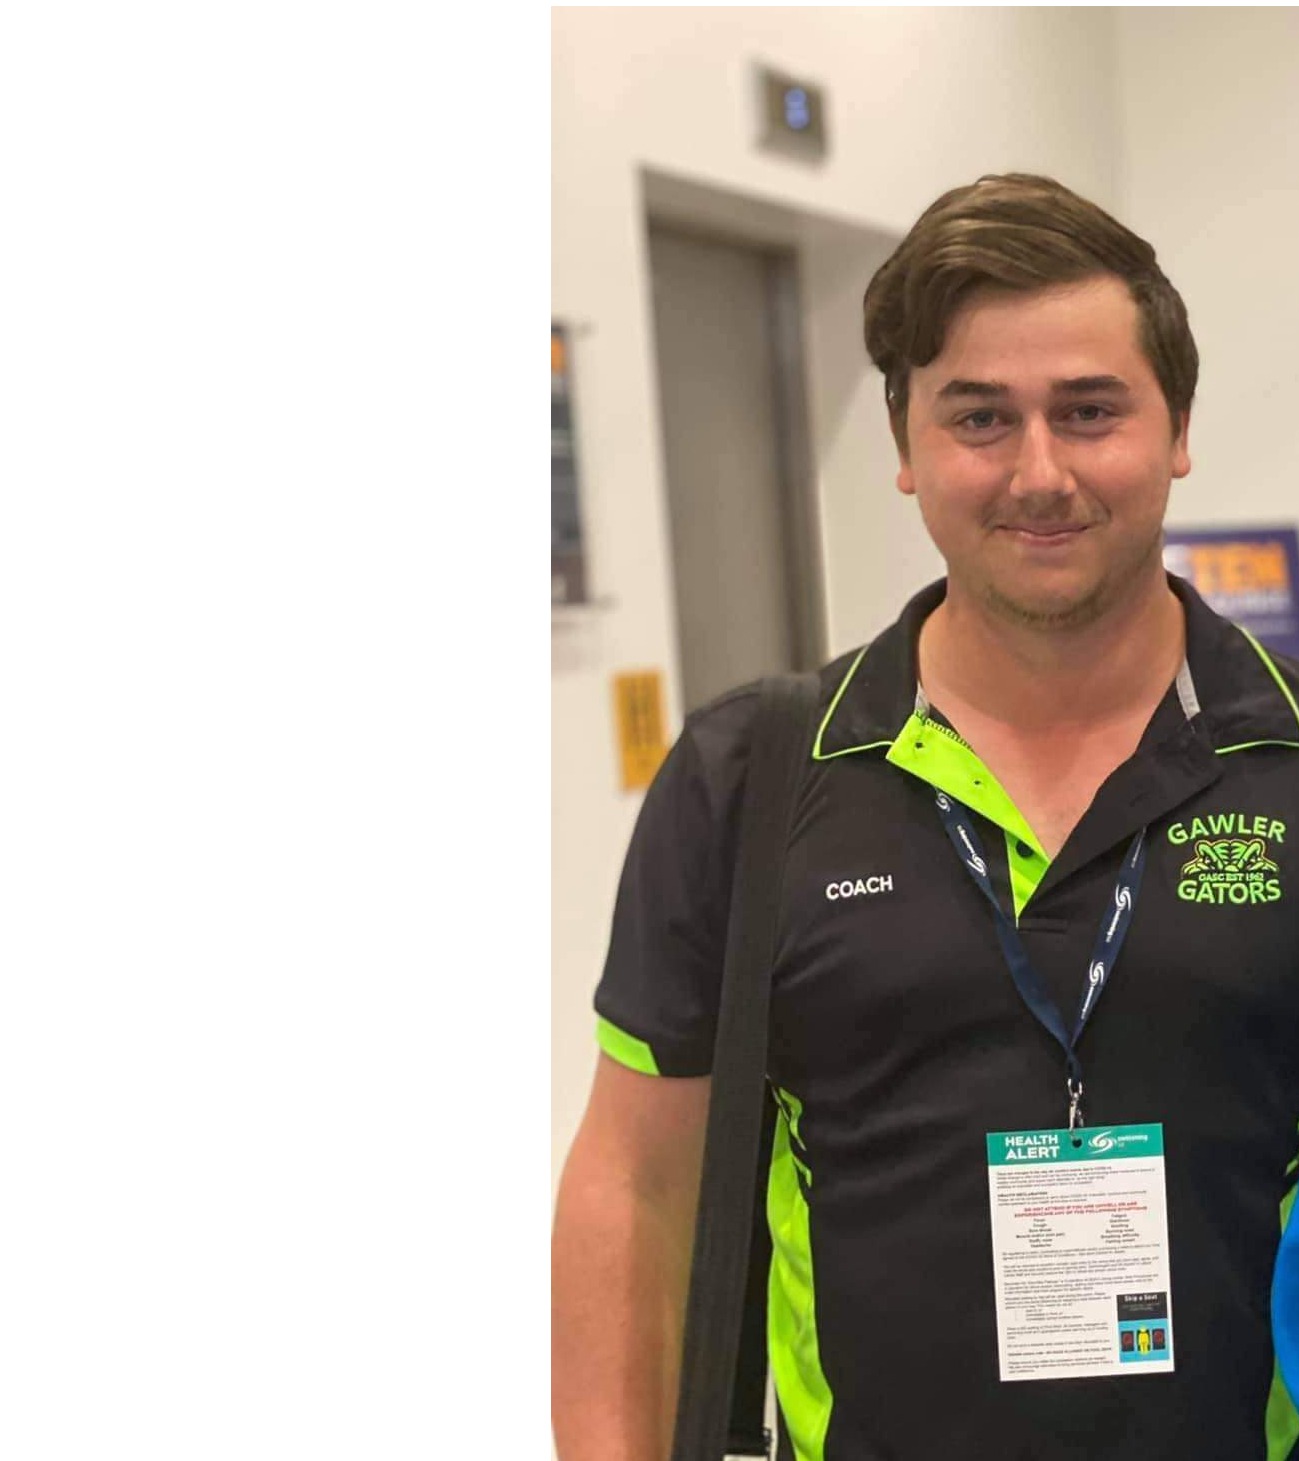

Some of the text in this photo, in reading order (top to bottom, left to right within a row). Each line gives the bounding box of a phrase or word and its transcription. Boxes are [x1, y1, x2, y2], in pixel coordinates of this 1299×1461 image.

[1167, 813, 1286, 845] GAWLER
[825, 874, 893, 901] COACH
[1177, 879, 1282, 905] GATORS
[1004, 1134, 1059, 1147] HEALTH
[1005, 1146, 1060, 1160] ALERT
